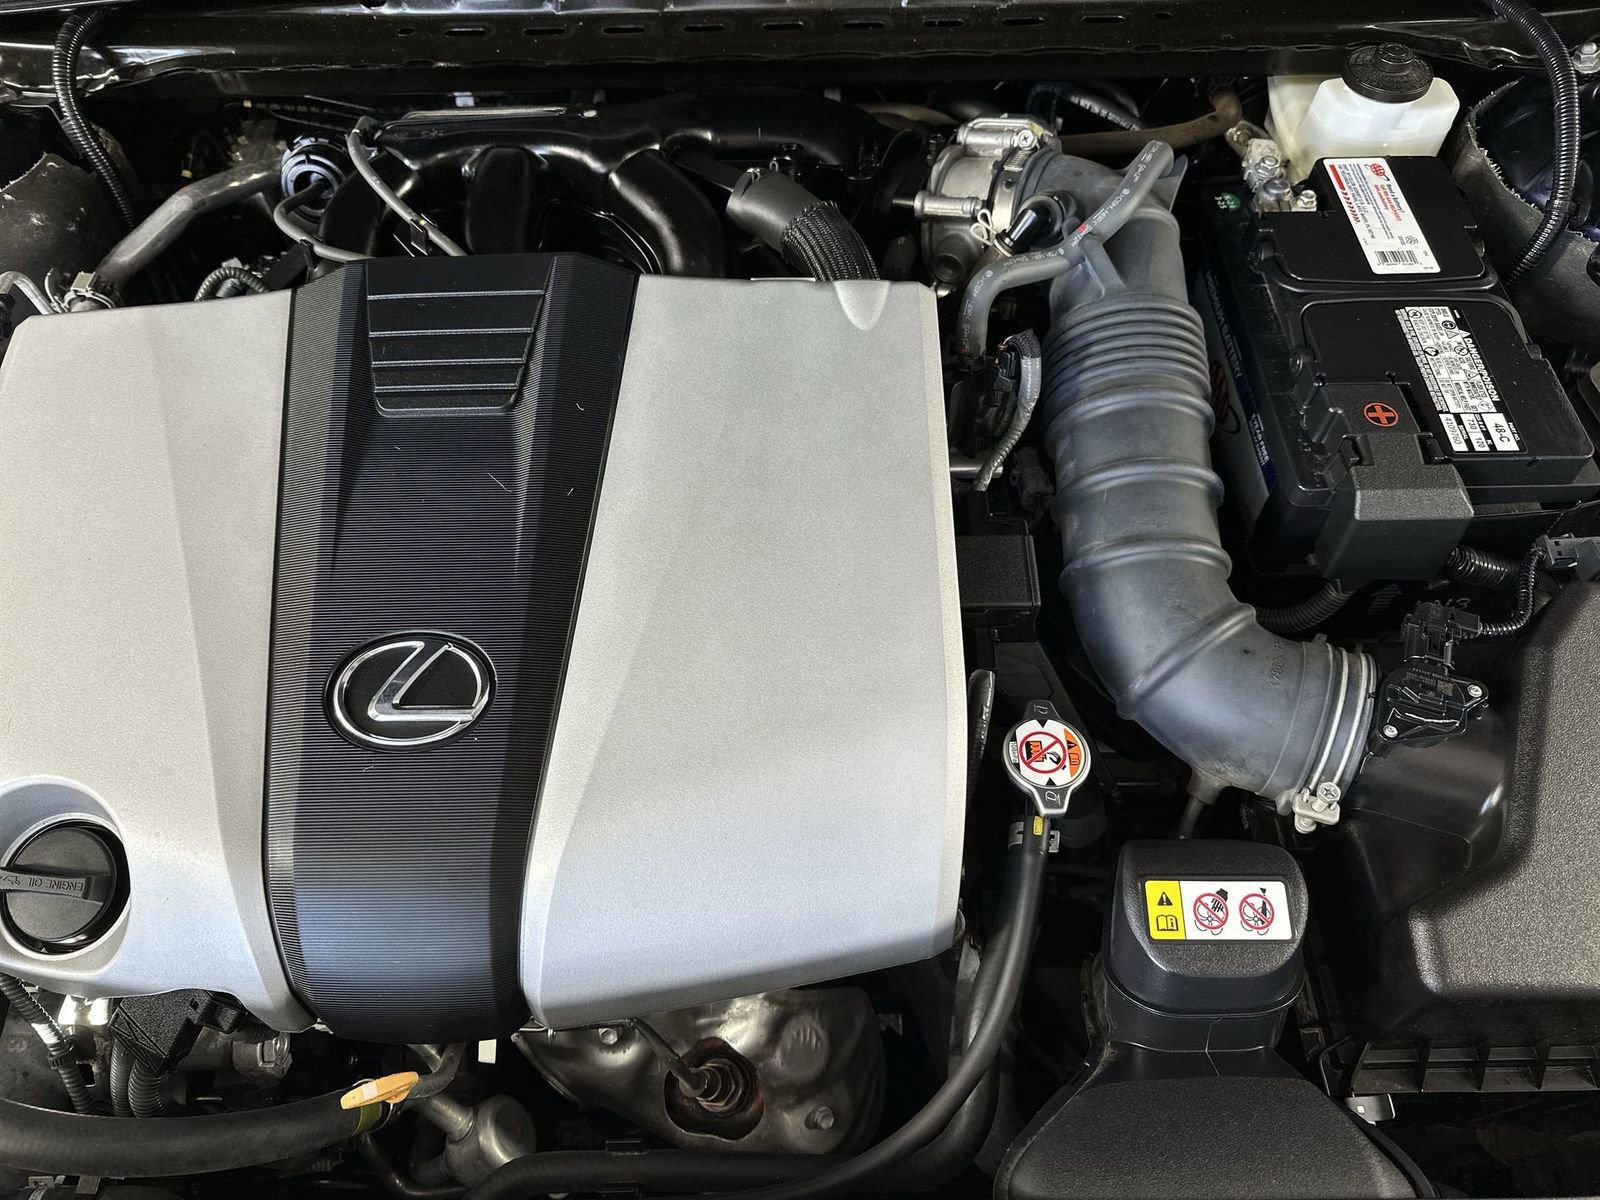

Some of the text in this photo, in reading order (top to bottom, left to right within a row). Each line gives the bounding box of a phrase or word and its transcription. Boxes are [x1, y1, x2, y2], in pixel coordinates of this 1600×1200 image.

[1463, 337, 1500, 401] DANGER/POISON
[1494, 422, 1510, 442] 48-C
[28, 877, 84, 892] ENGINE OIL
